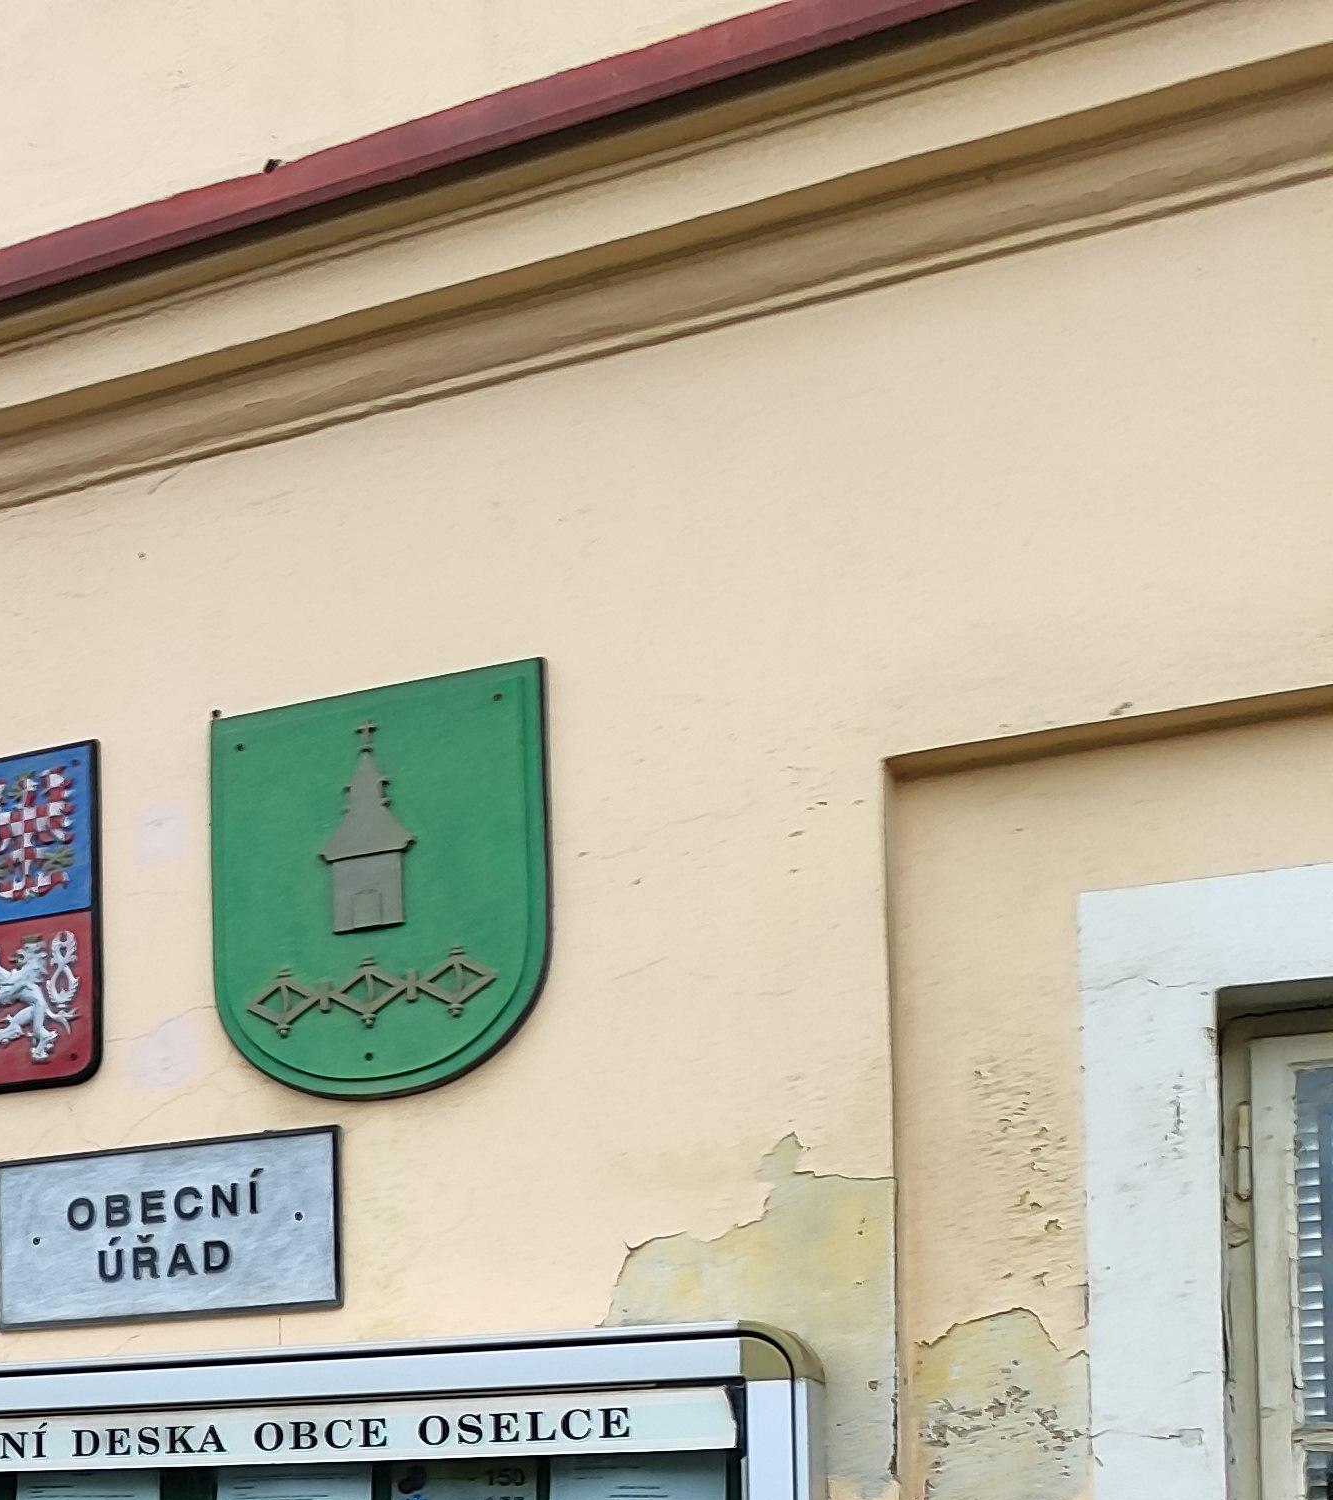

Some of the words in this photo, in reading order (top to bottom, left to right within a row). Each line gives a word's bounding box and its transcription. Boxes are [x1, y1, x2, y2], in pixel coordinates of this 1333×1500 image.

[67, 1168, 264, 1231] OBECNÍ
[98, 1233, 232, 1283] ÚŘAD
[71, 1424, 229, 1457] DESKA
[253, 1417, 388, 1452] OBCE
[418, 1407, 631, 1446] OSELCE
[485, 1468, 526, 1487] 150
